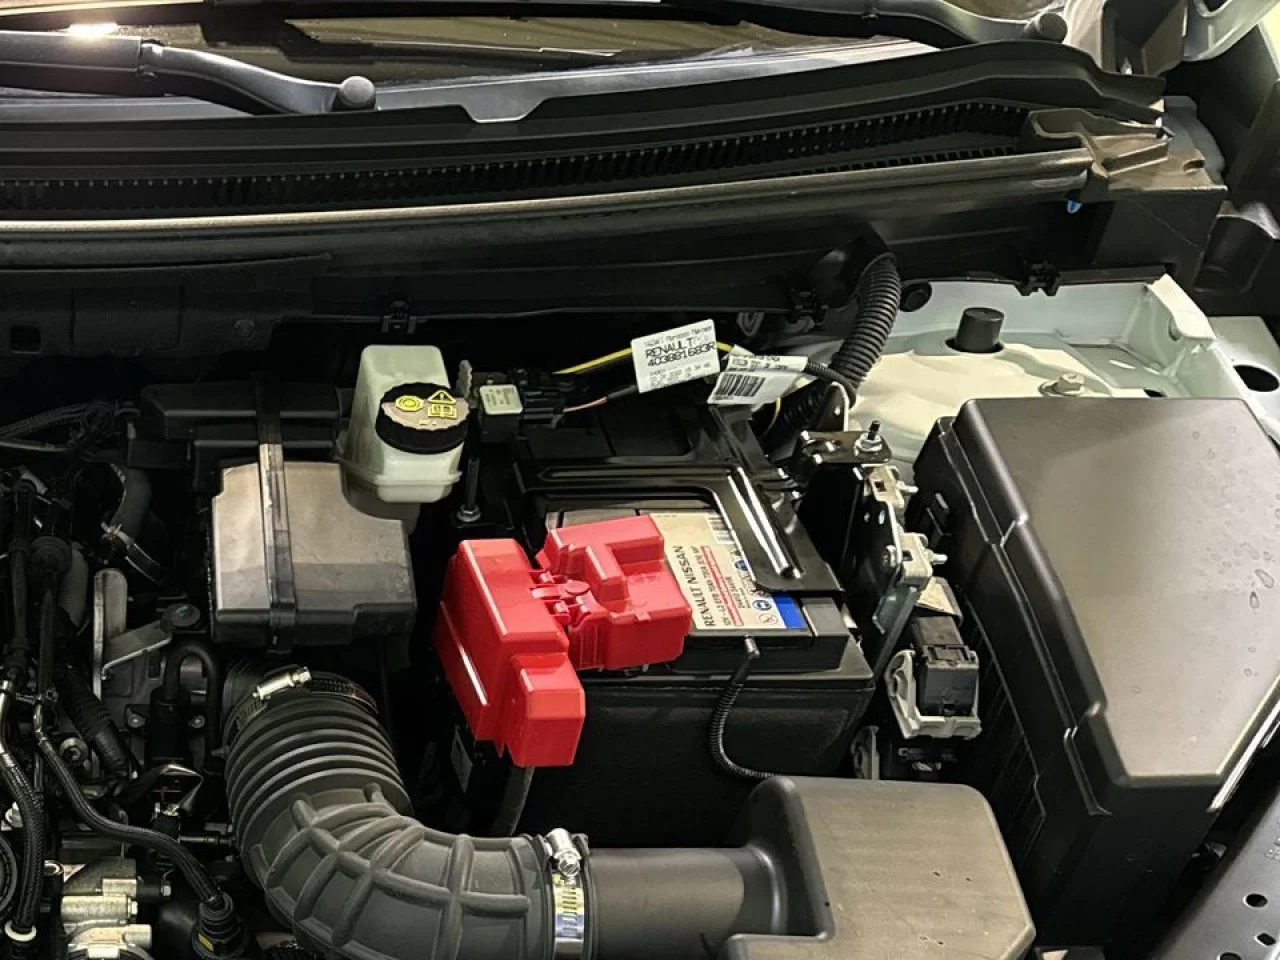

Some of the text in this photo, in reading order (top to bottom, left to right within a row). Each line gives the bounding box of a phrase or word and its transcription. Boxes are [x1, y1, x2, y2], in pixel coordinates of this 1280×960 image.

[645, 336, 694, 359] RENAULT
[672, 545, 716, 627] RENAULT NISSAN
